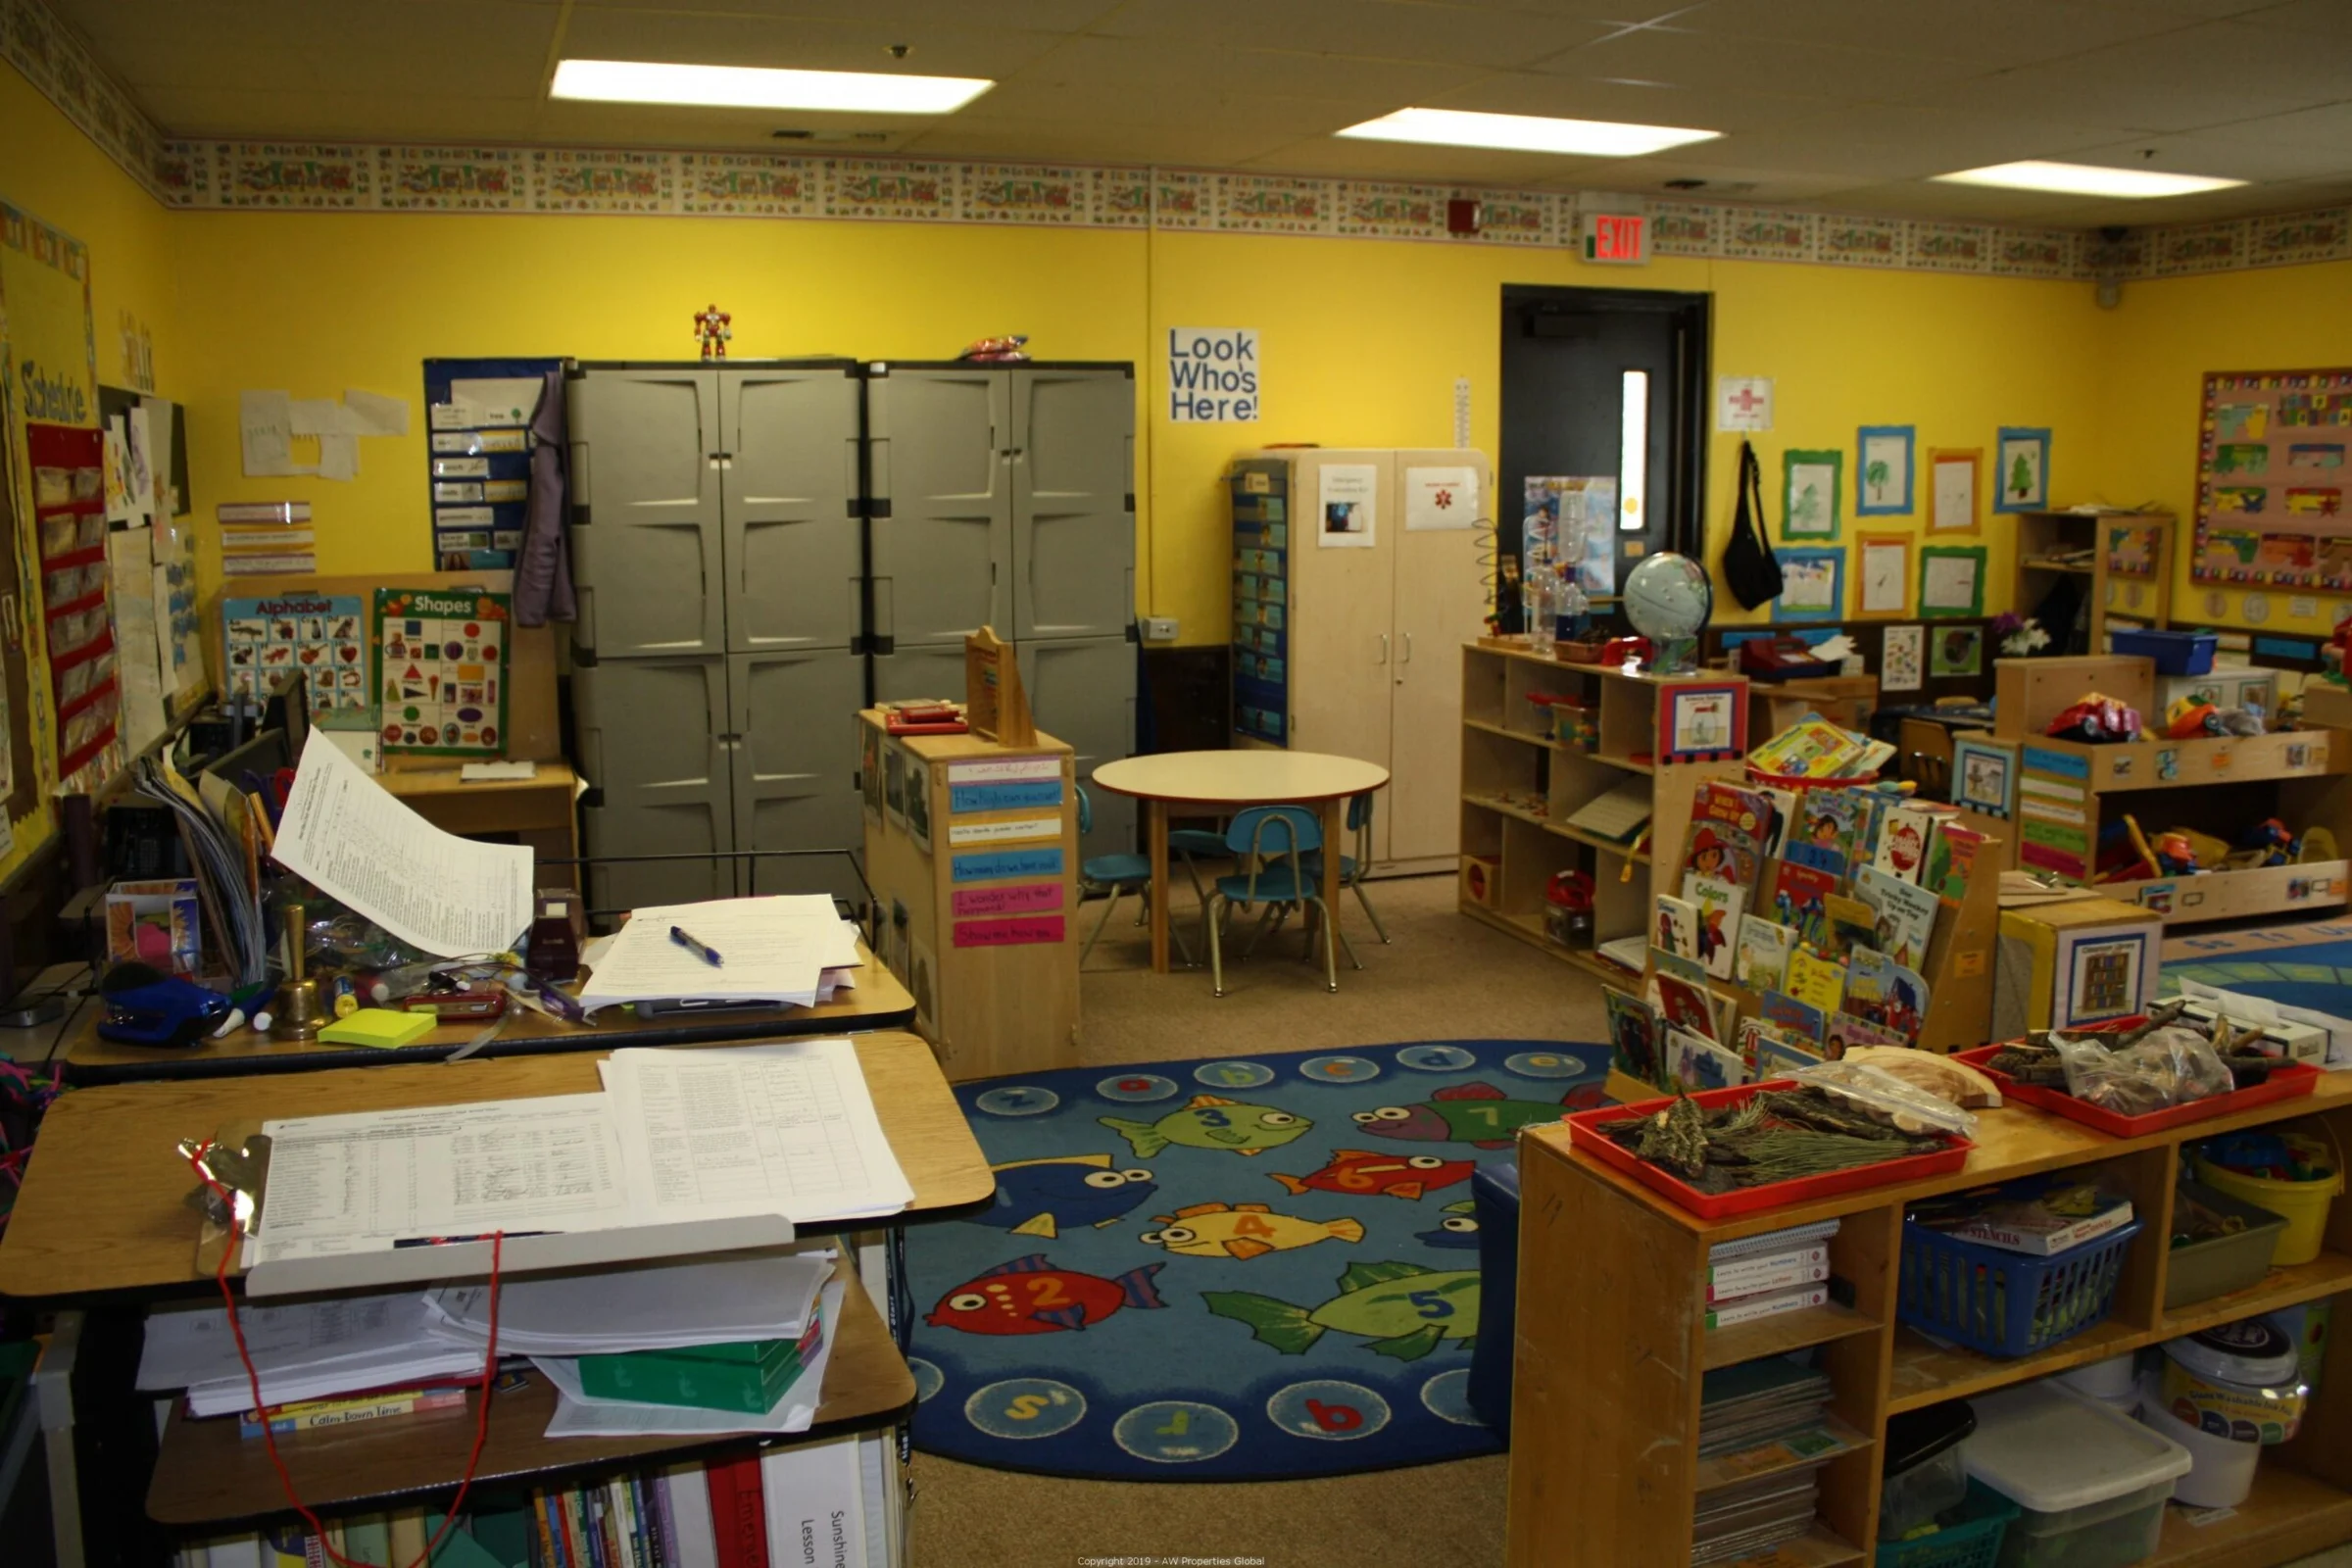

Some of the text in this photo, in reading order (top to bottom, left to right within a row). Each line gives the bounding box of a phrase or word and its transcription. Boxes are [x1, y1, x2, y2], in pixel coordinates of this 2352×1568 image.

[1596, 215, 1643, 260] EXIT
[1170, 328, 1253, 361] Look
[1170, 359, 1256, 393] Who's
[22, 359, 87, 423] Schedule
[1171, 391, 1257, 420] Here!
[256, 599, 332, 617] Alphabet
[415, 596, 472, 615] Shapes
[1695, 882, 1729, 904] Colors
[1117, 1076, 1151, 1092] a
[1219, 1069, 1256, 1085] b
[1419, 1052, 1454, 1067] d
[1528, 1055, 1560, 1067] e
[1194, 1108, 1231, 1127] 3
[1467, 1106, 1498, 1126] 7
[1337, 1167, 1375, 1188] 6
[1233, 1215, 1277, 1238] 4
[1969, 1226, 2021, 1246] STENCILS
[1026, 1277, 1071, 1307] 2
[1406, 1291, 1455, 1319] 5
[376, 1405, 403, 1420] Time
[738, 1490, 761, 1568] Emerge
[801, 1519, 815, 1565] Lesson
[831, 1510, 846, 1568] Sunshine
